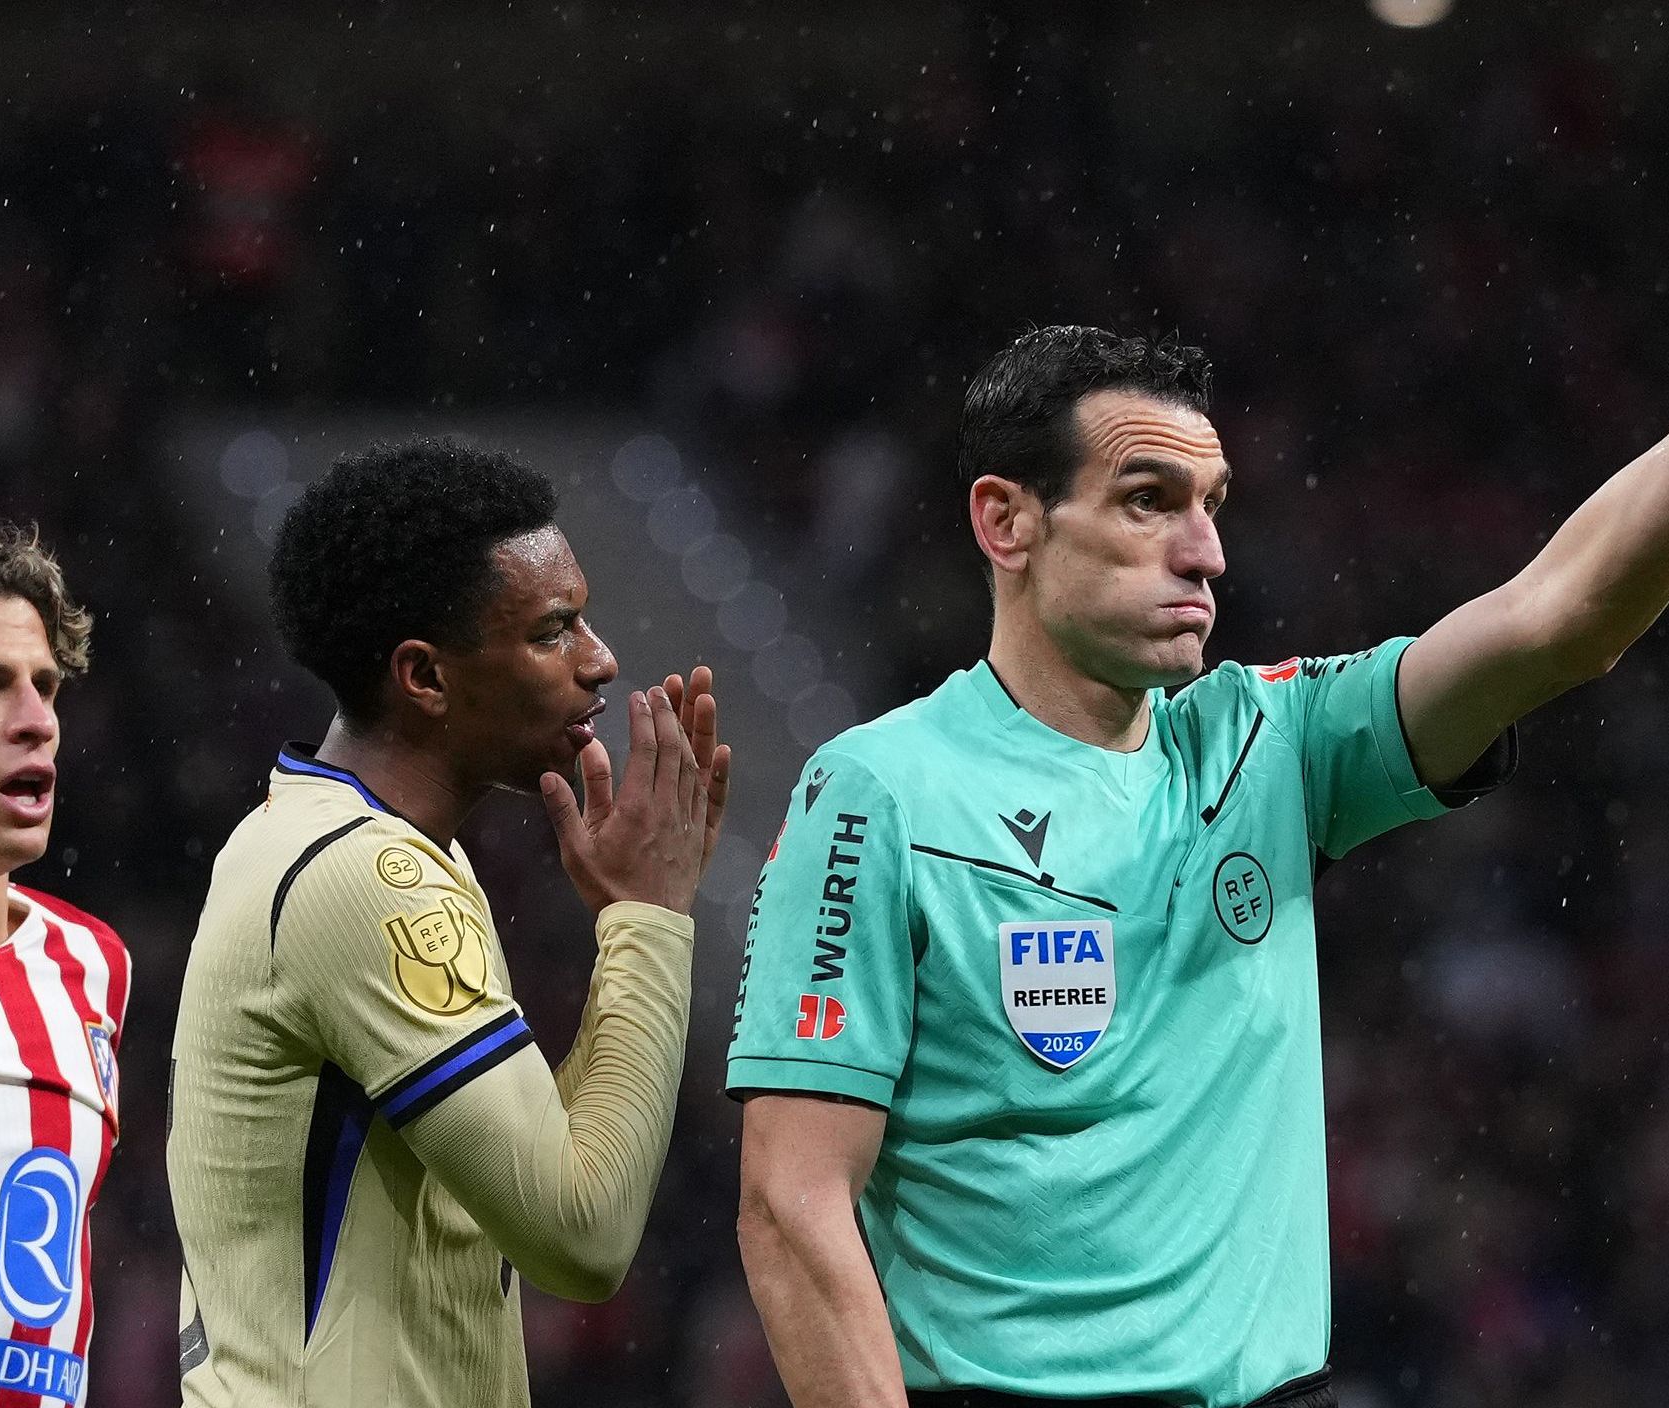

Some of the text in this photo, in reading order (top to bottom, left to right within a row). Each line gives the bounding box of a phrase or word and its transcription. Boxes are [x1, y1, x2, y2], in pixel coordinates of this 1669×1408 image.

[386, 859, 415, 875] 32
[811, 813, 869, 983] WÜRTH
[1011, 930, 1105, 966] FIFA
[1013, 987, 1107, 1008] REFEREE
[1042, 1036, 1084, 1053] 2026
[57, 1358, 82, 1400] AIR
